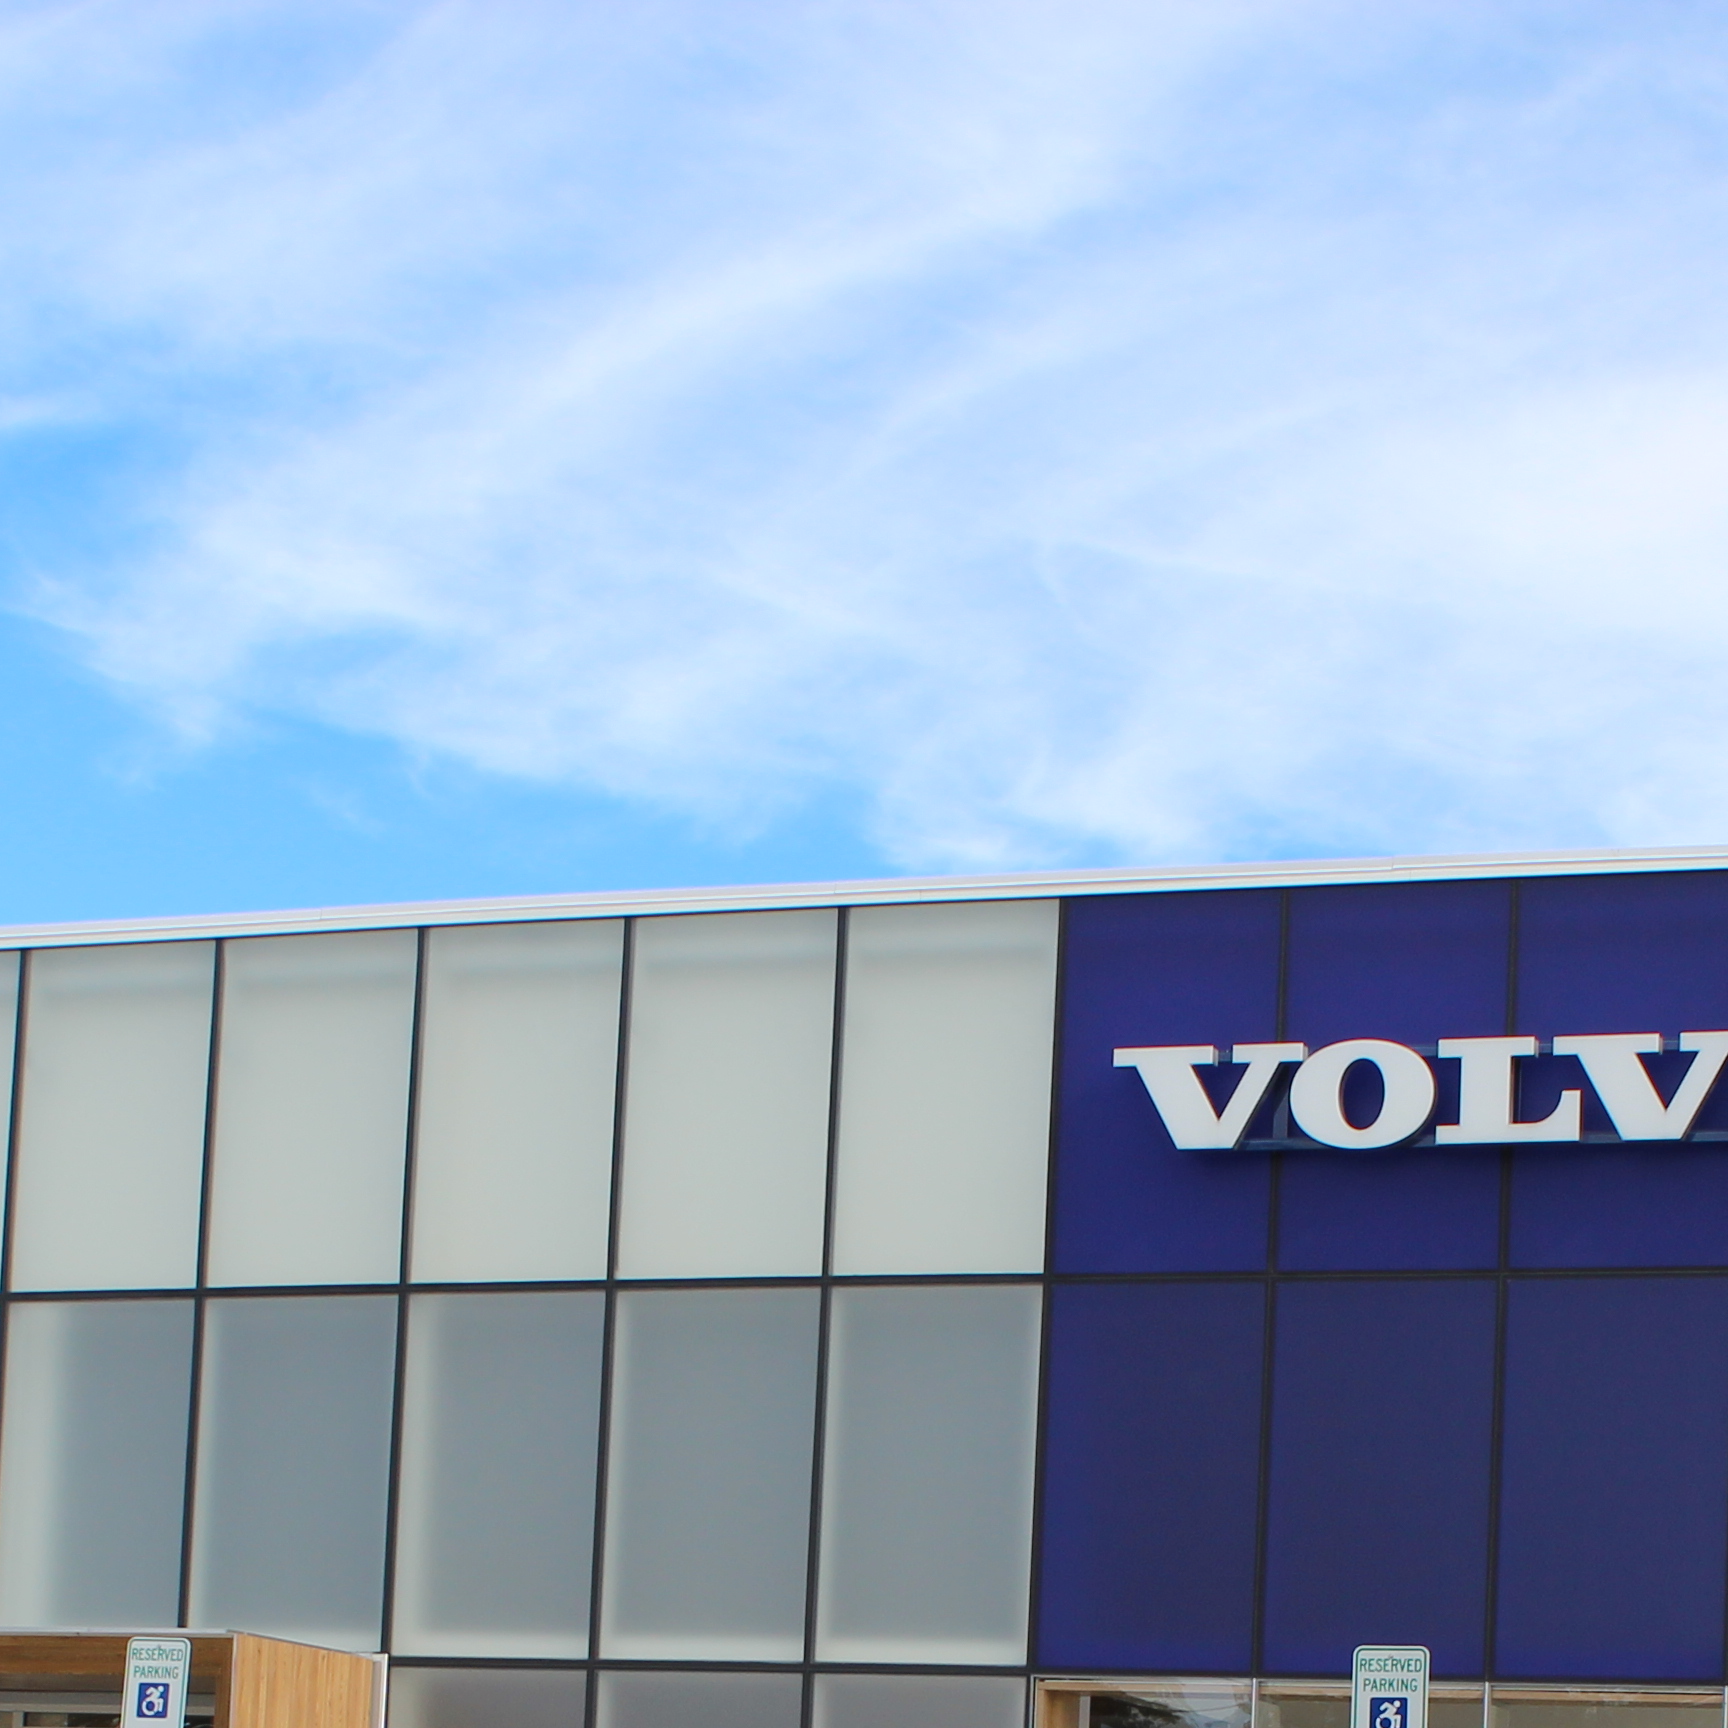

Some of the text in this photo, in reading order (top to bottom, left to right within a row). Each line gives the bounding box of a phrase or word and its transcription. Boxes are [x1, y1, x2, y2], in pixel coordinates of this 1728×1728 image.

[131, 1647, 184, 1662] RESERVED
[133, 1665, 179, 1679] PARKING
[1359, 1658, 1423, 1673] RESERVED
[1363, 1678, 1418, 1693] PARKING
